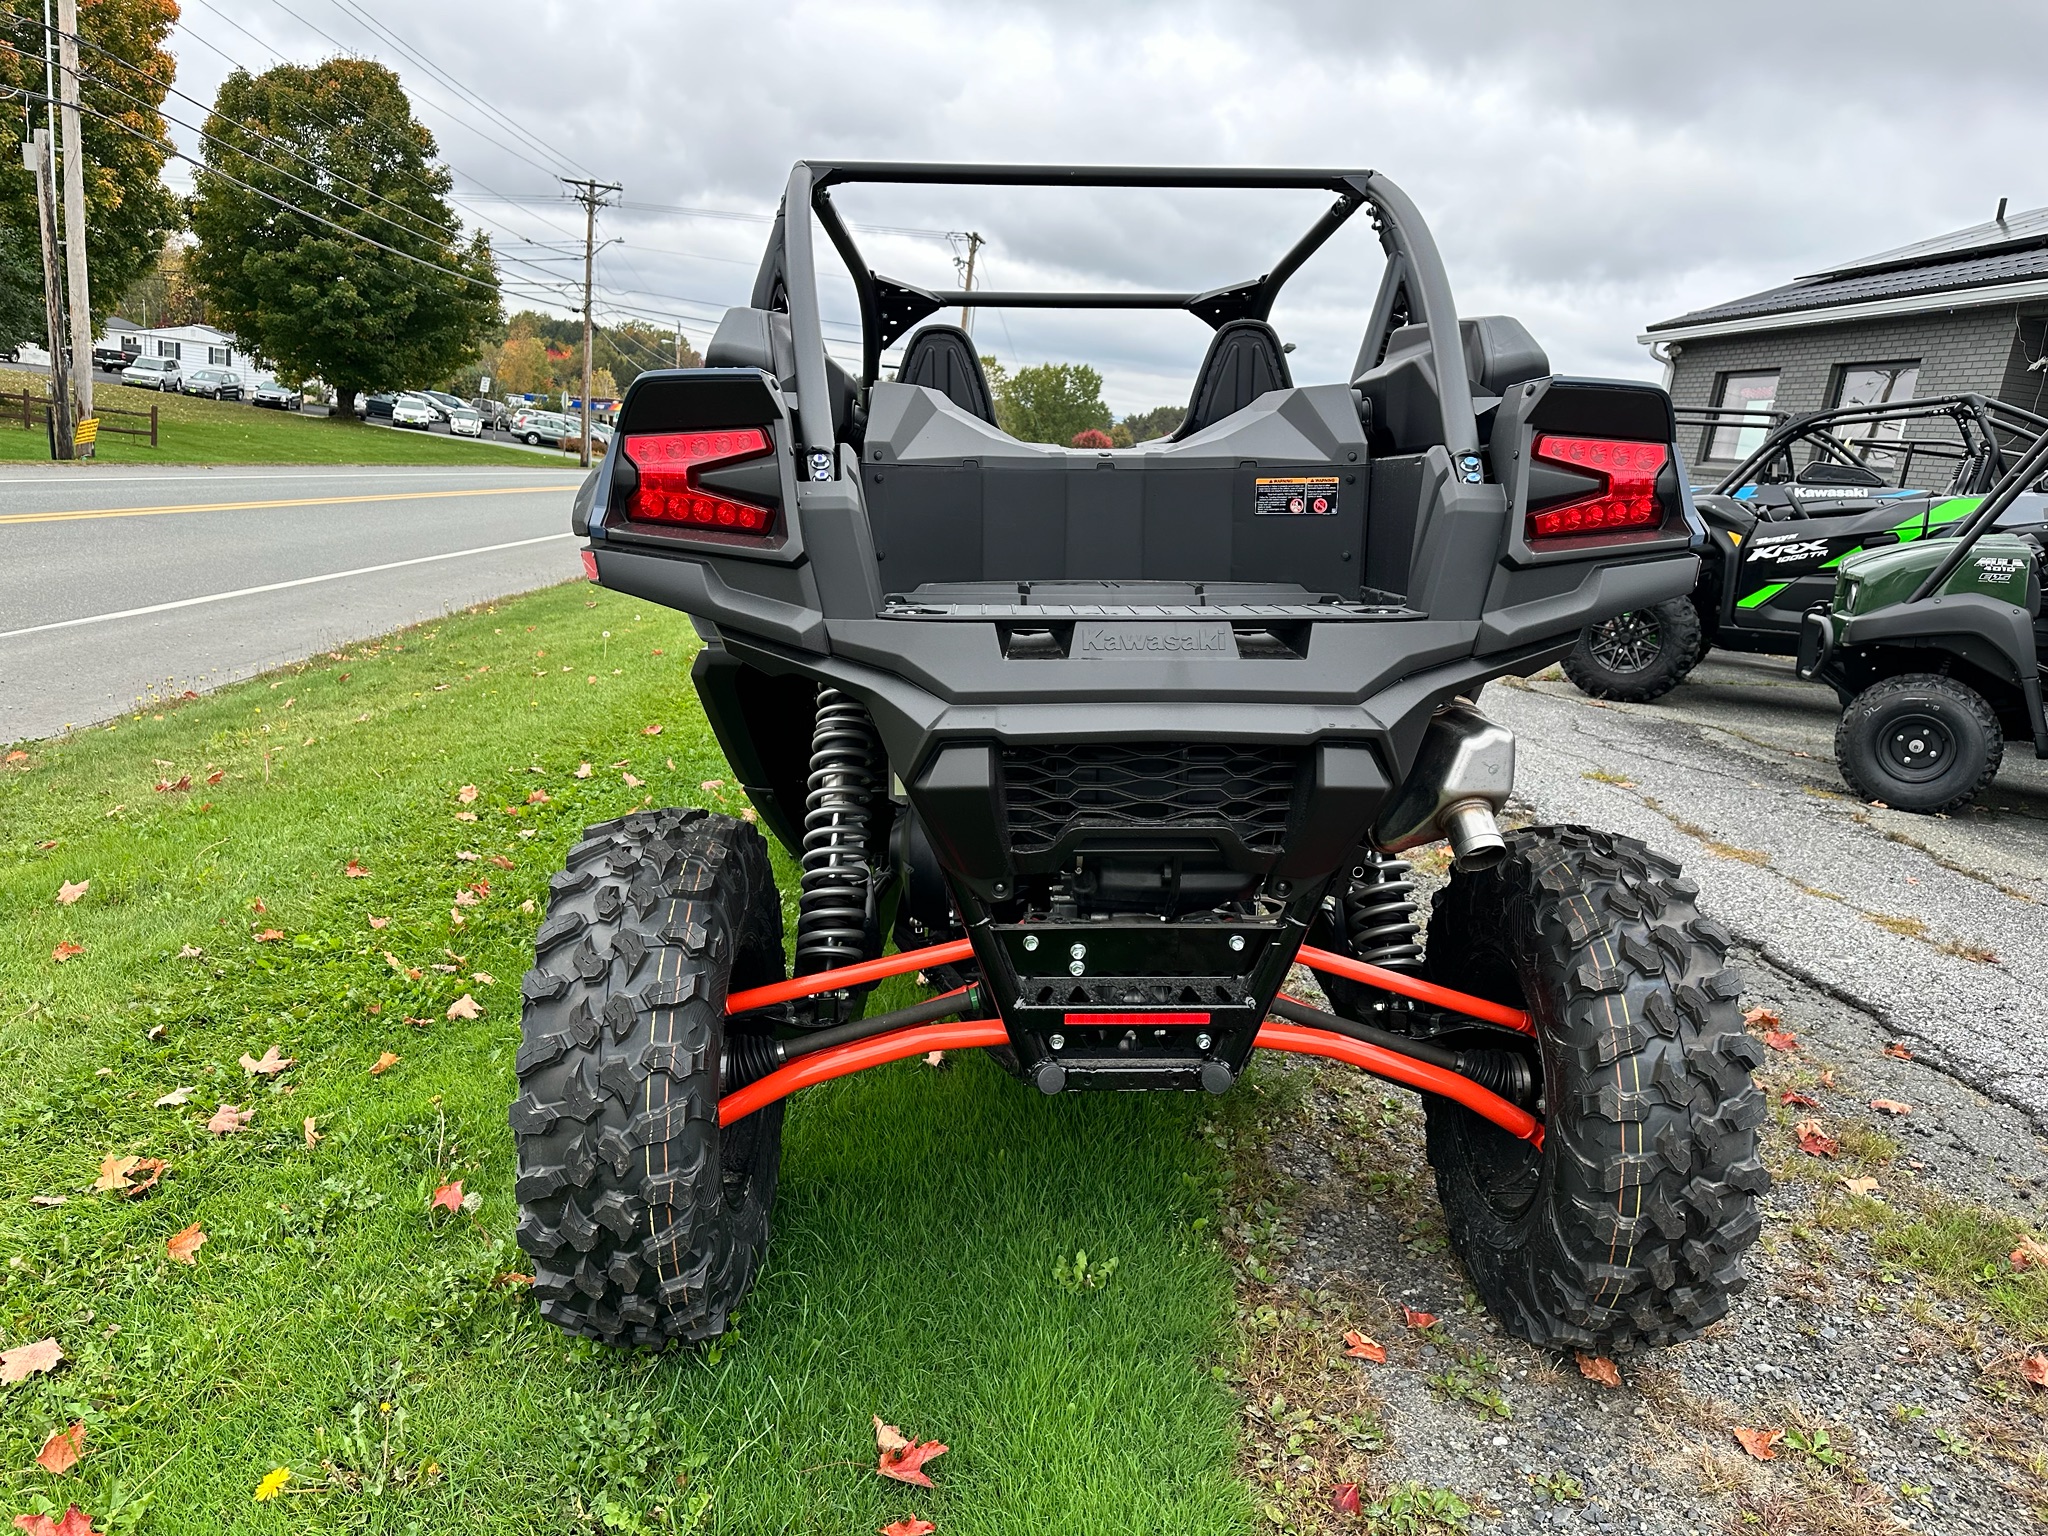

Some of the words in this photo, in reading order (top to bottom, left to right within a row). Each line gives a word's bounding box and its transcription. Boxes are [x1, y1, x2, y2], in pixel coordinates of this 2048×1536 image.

[1794, 487, 1869, 498] Kawasaki
[1746, 538, 1829, 562] KRX
[1082, 629, 1226, 651] Kawasaki
